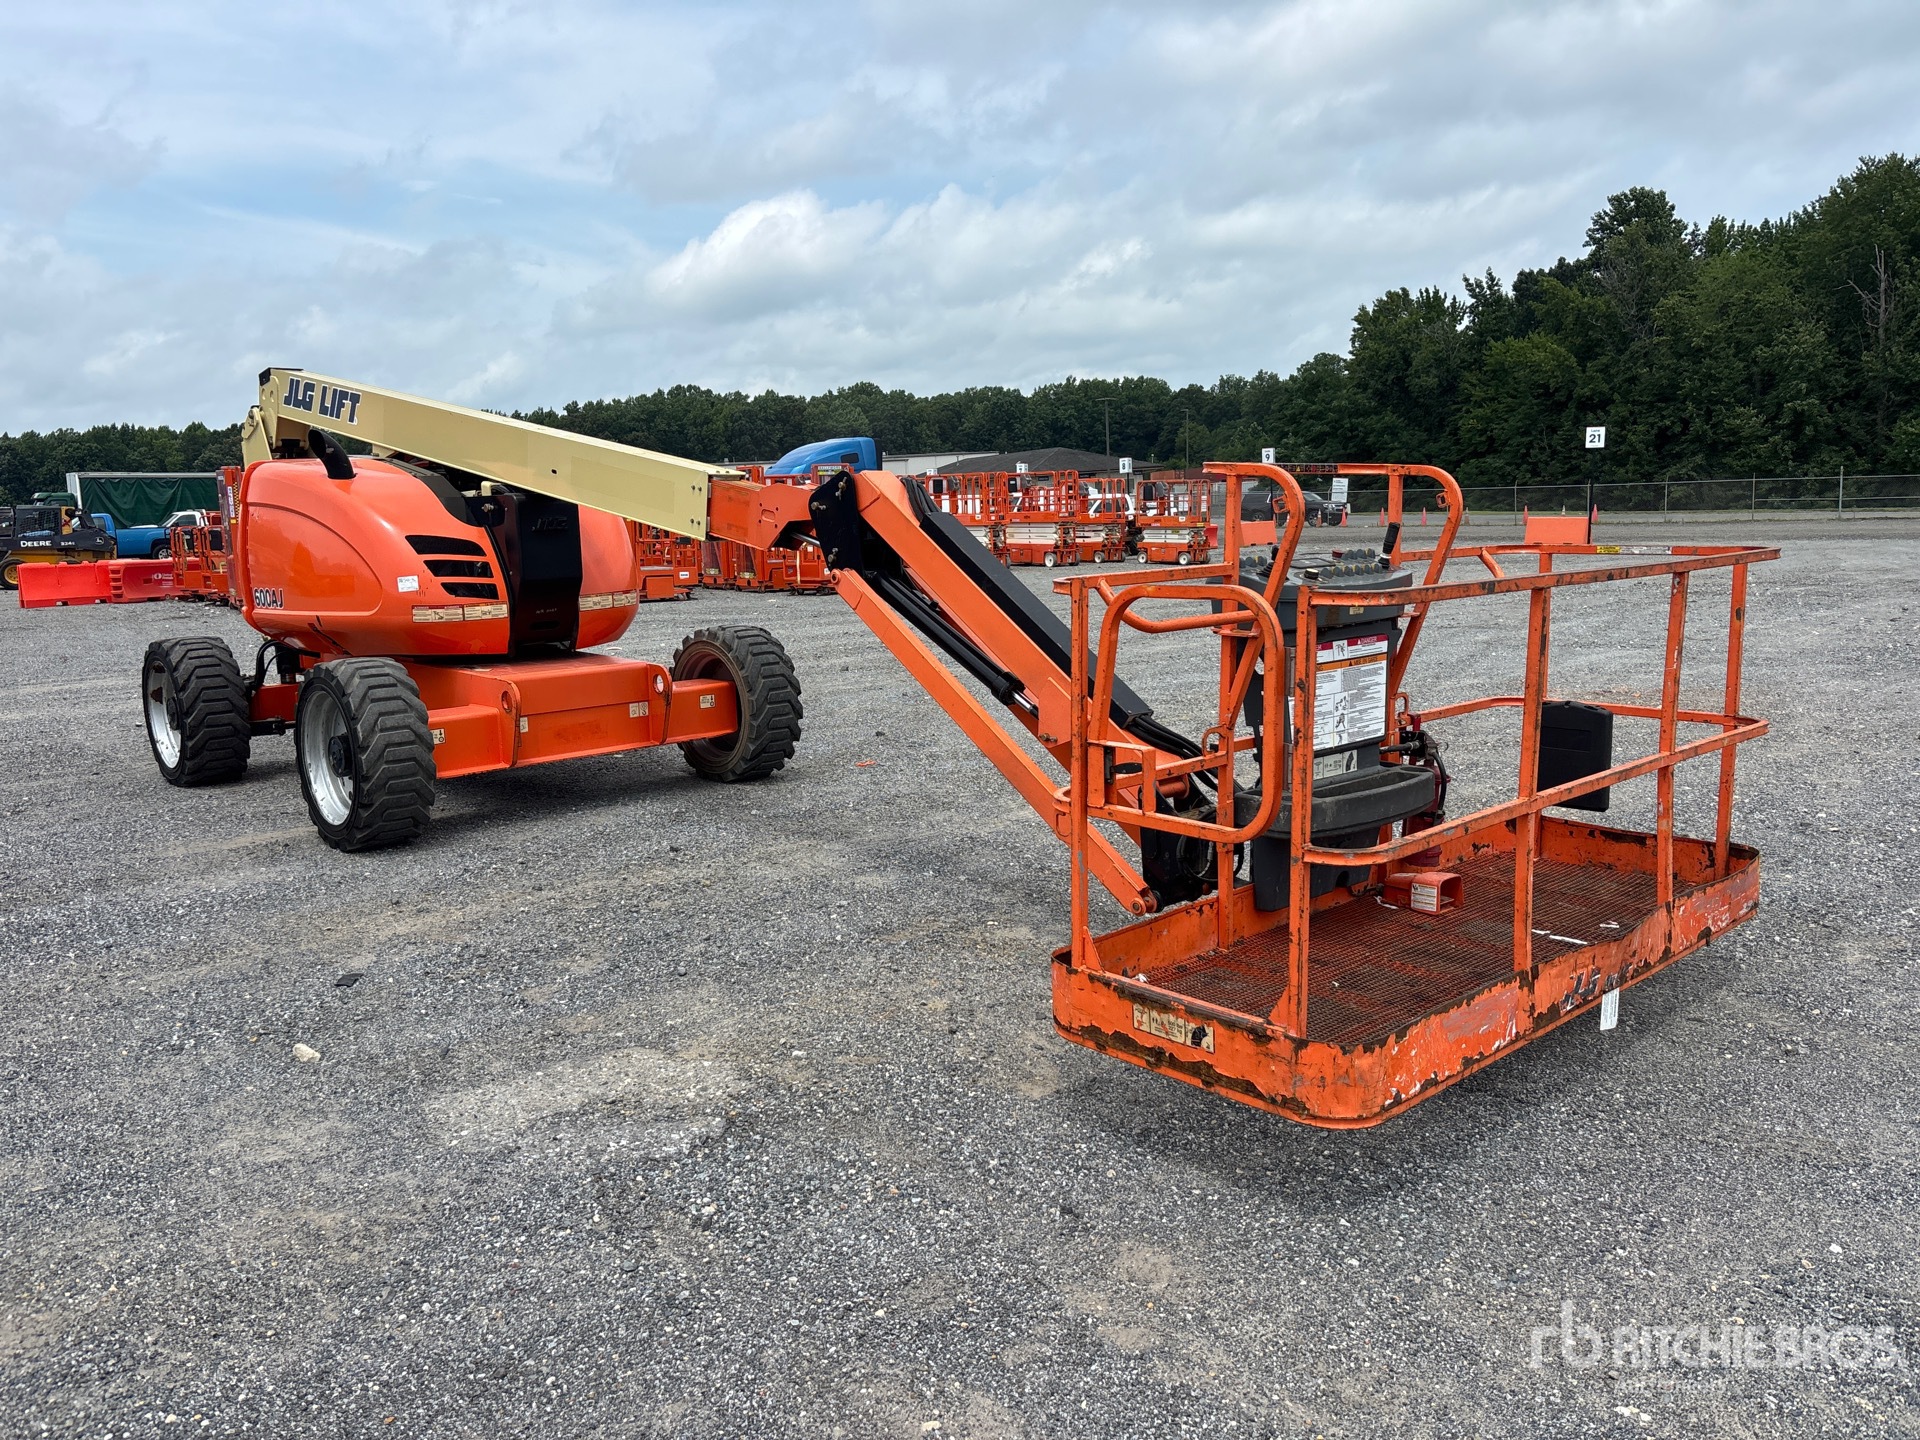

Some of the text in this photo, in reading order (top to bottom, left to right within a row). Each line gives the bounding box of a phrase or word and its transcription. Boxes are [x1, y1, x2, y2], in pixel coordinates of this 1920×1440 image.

[283, 376, 362, 424] JLG LIFT
[1588, 433, 1601, 444] 21
[1264, 453, 1271, 462] 9
[20, 540, 52, 548] DEERE
[253, 587, 284, 609] 600AJ
